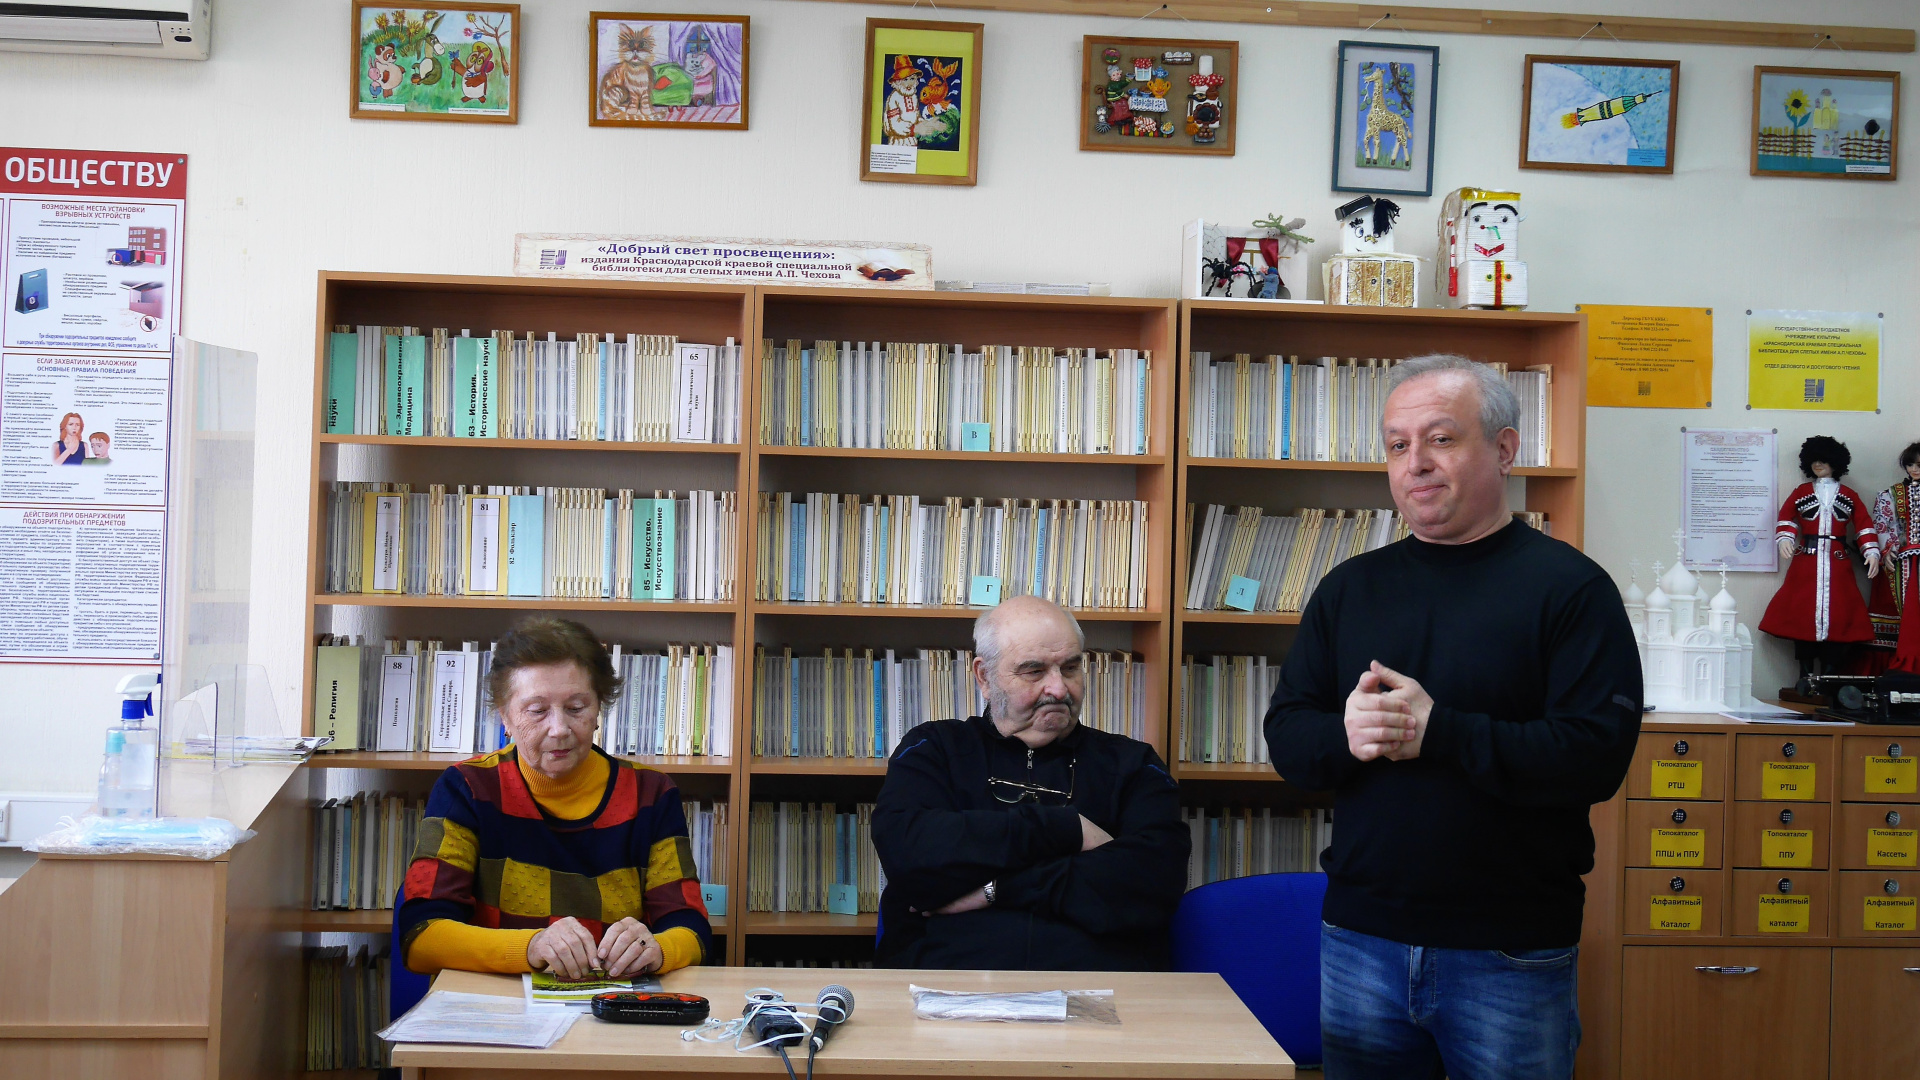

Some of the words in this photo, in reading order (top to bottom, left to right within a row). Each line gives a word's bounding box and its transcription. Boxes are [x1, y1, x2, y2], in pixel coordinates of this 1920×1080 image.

[5, 157, 174, 188] ОБЩЕСТВУ
[41, 203, 85, 211] ВОЗМОЖНЫЕ
[95, 211, 131, 219] УСТРОЙСТВ
[598, 243, 670, 255] «Добрый
[713, 248, 835, 260] просвещения»:
[581, 256, 630, 264] издания
[633, 256, 722, 267] Краснодарской
[725, 259, 773, 269] краевой
[776, 261, 852, 271] специальной
[592, 264, 663, 273] библиотеки
[665, 267, 687, 275] для
[689, 268, 733, 276] слепых
[735, 269, 773, 277] имени
[775, 270, 798, 278] А.П.
[801, 270, 841, 279] Чехова
[469, 374, 477, 416] История.
[480, 369, 488, 437] Исторические
[405, 387, 413, 435] Медицина
[469, 425, 475, 437] 63
[384, 501, 391, 509] 70
[86, 519, 125, 527] ПРЕДМЕТОВ
[644, 518, 652, 570] Искусство.
[655, 507, 663, 591] Искусствознание
[509, 557, 515, 565] 82
[644, 580, 650, 591] 85
[329, 680, 338, 720] Религия
[1885, 777, 1897, 785] ФК
[1780, 783, 1797, 791] РТШ
[1658, 829, 1699, 837] Топокаталог
[1779, 851, 1795, 859] ППУ
[1877, 850, 1907, 858] Кассеты
[839, 892, 846, 901] Д
[1651, 898, 1701, 906] Алфавитный
[1760, 897, 1809, 905] Алфавитный
[1866, 899, 1914, 907] Алфавитный
[1660, 921, 1690, 929] Каталог
